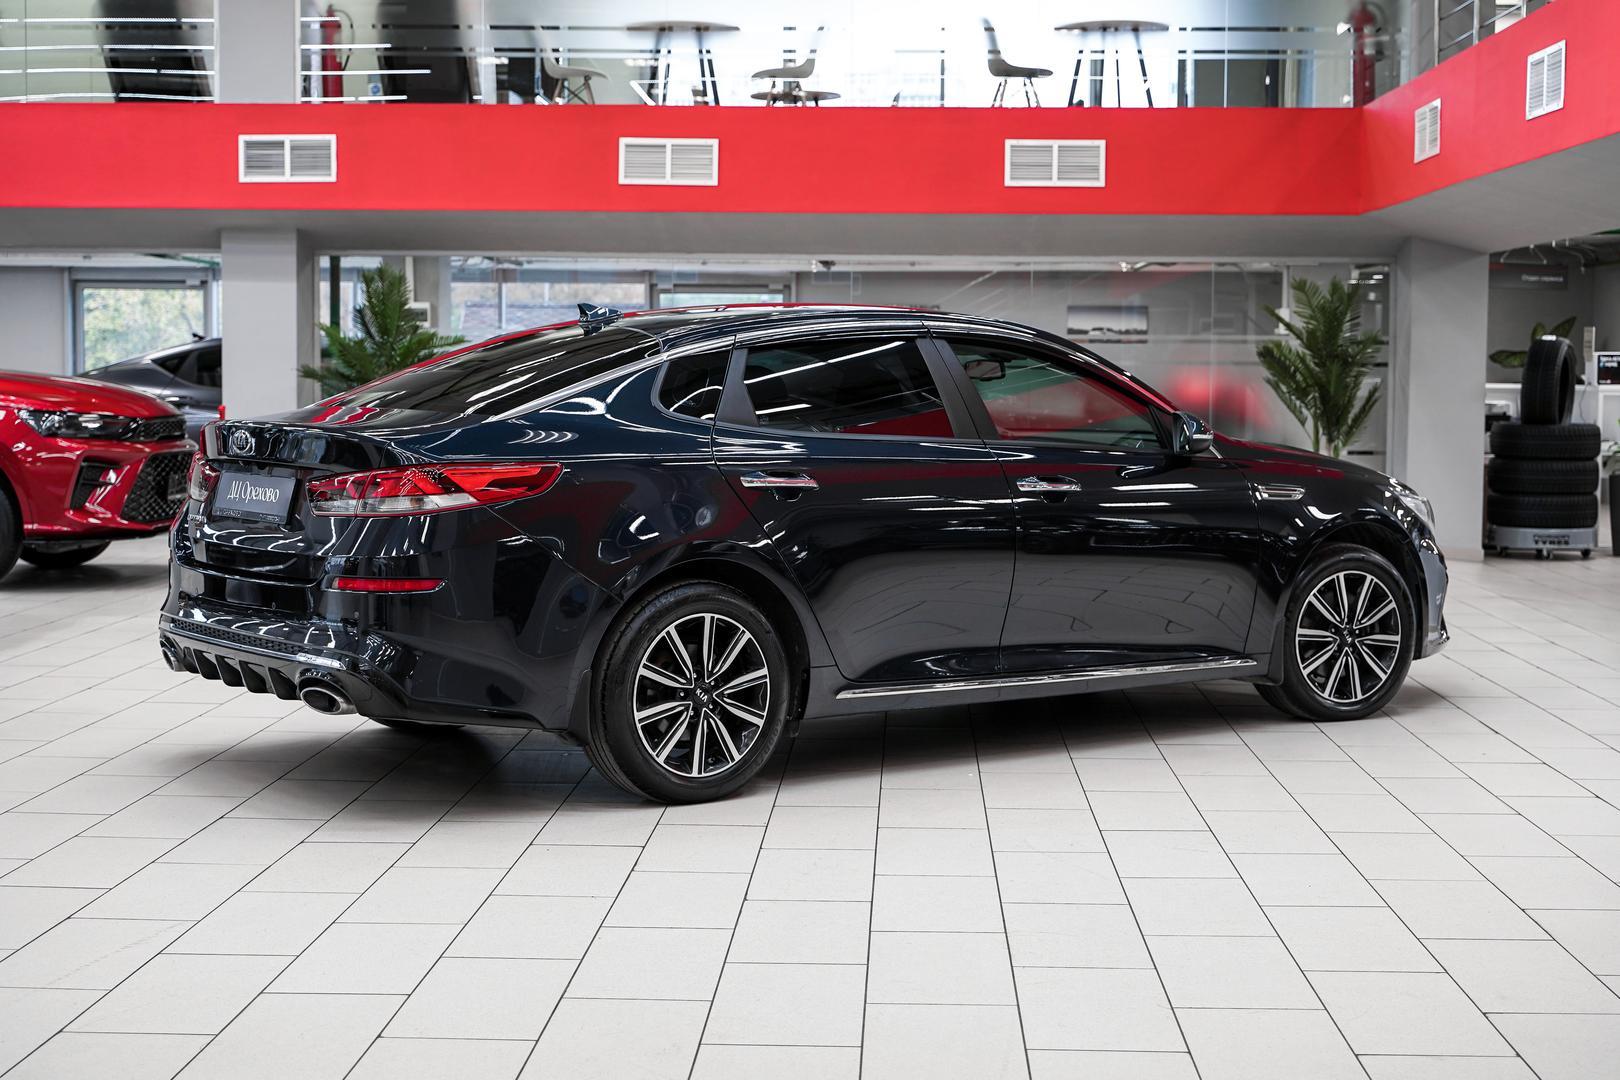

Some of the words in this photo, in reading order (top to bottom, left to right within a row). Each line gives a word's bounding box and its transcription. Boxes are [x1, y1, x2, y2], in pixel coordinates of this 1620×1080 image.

[227, 480, 242, 502] ДЦ
[241, 481, 280, 503] Орехово
[695, 688, 708, 703] KIA
